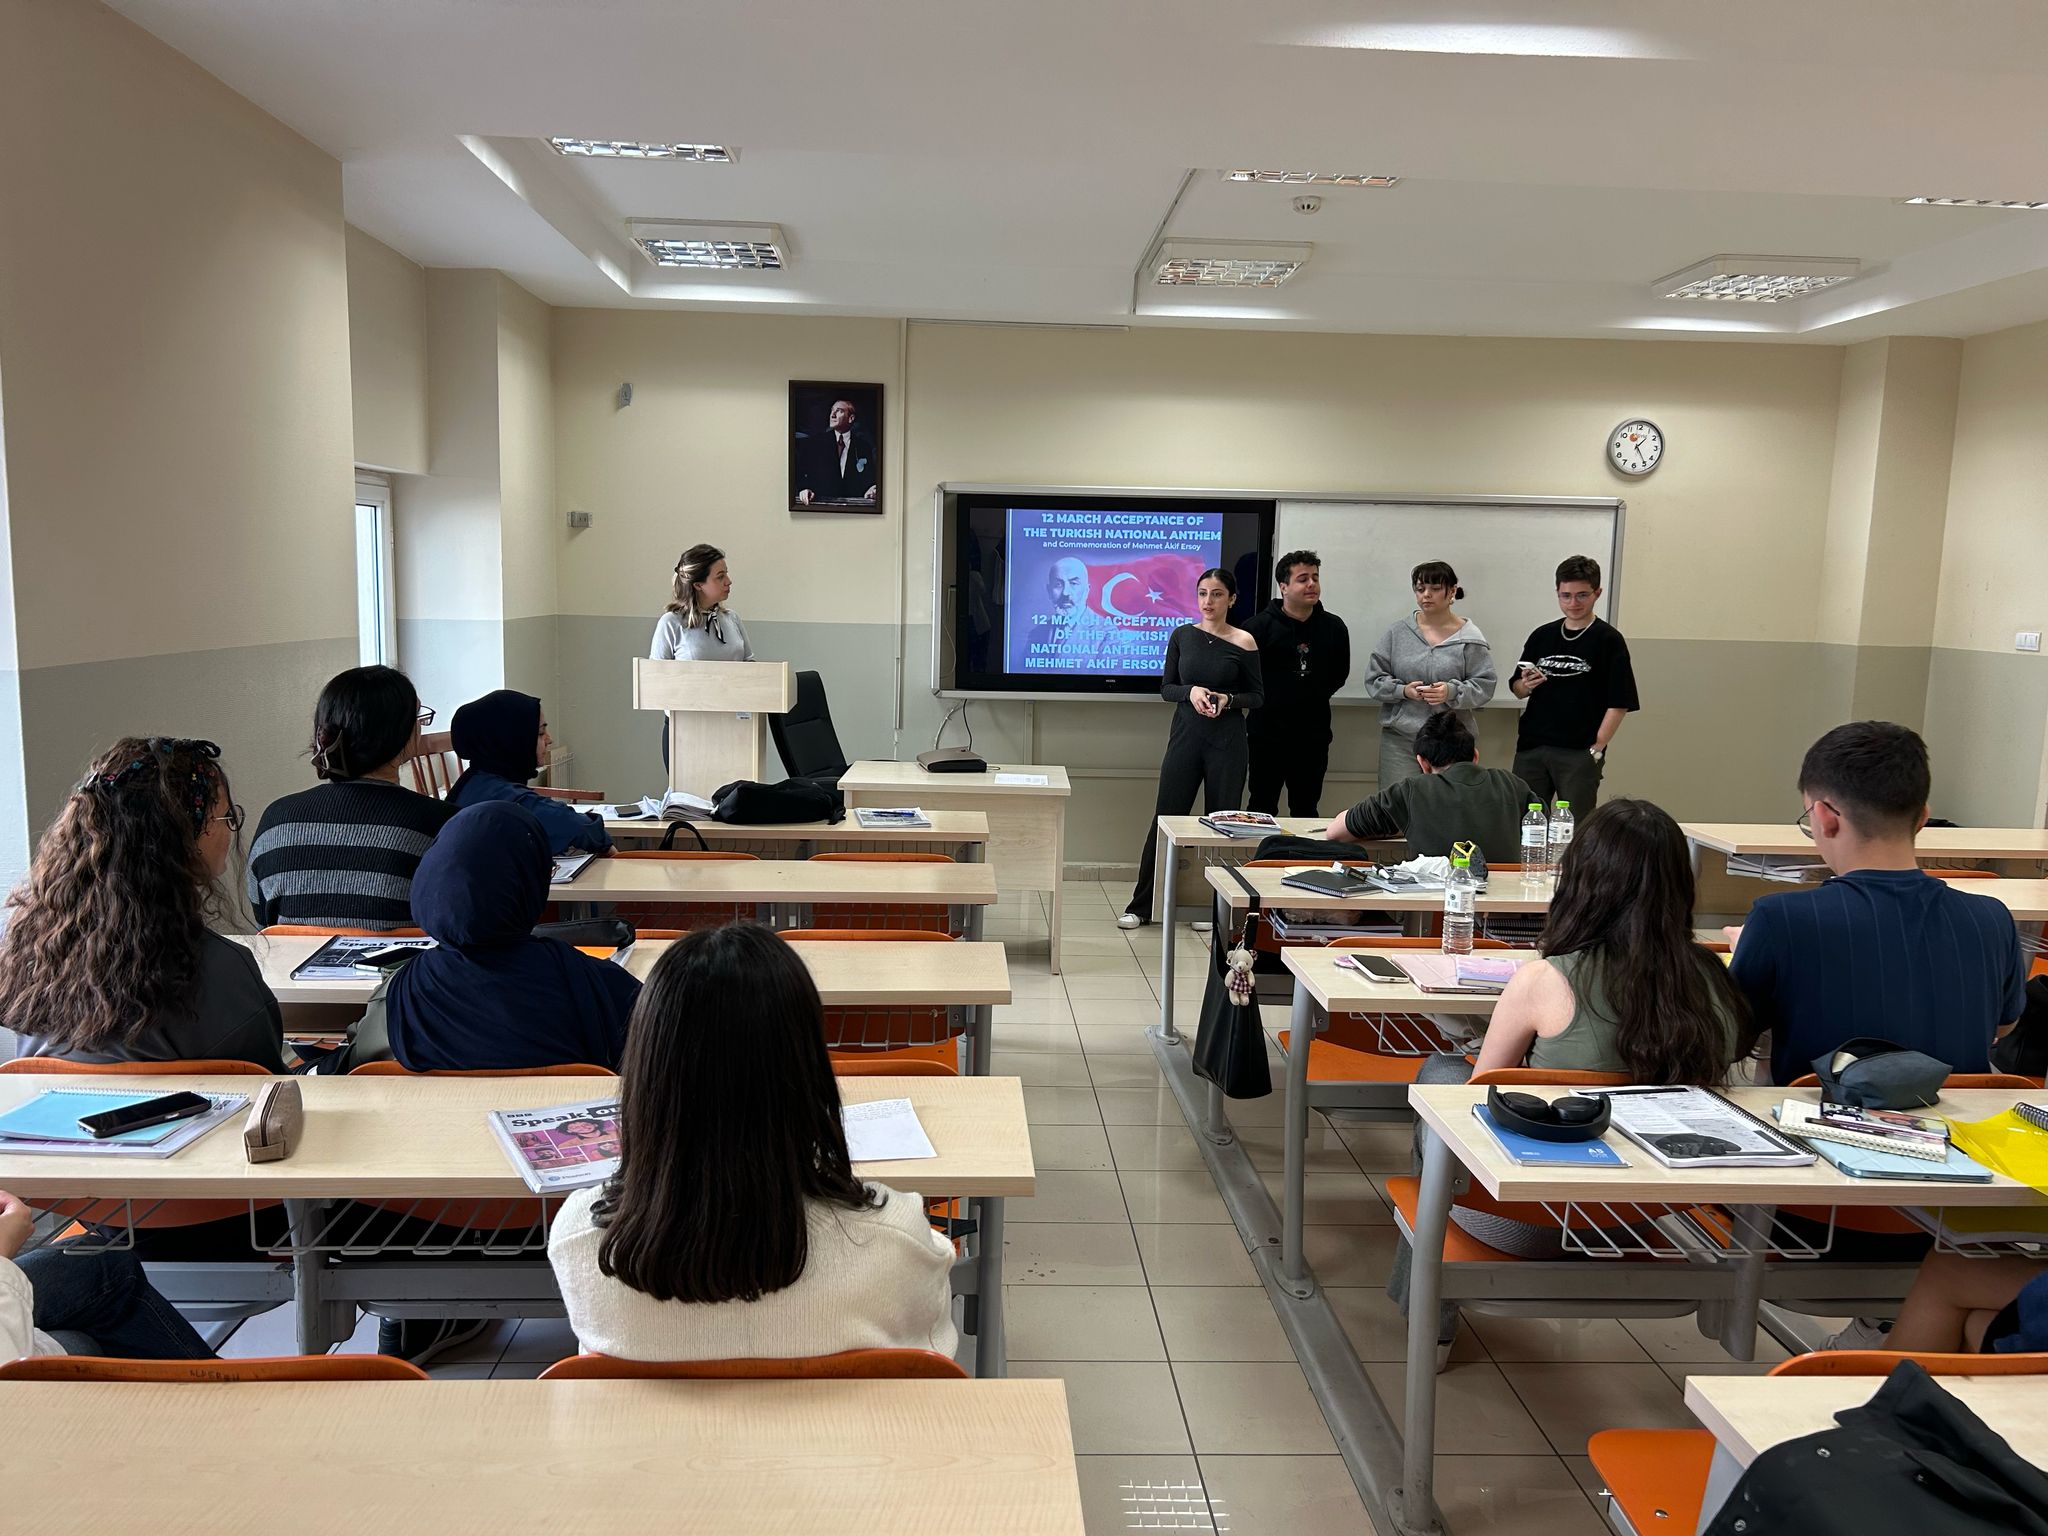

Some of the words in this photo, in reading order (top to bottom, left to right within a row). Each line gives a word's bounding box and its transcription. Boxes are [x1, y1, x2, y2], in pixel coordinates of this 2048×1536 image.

[1041, 513, 1054, 523] 12
[1056, 513, 1101, 524] MARCH
[1104, 514, 1184, 525] ACCEPTANCE
[1186, 516, 1204, 526] OF
[1023, 527, 1047, 538] THE
[1050, 527, 1102, 539] TURKISH
[1105, 529, 1167, 540] NATIONAL
[1169, 530, 1221, 541] ANTHEM
[1059, 541, 1121, 549] Commemoration
[1122, 541, 1131, 549] of
[1132, 542, 1163, 550] Mehmet
[1181, 543, 1201, 552] Ersoy
[1031, 614, 1047, 625] 12
[1051, 615, 1100, 626] MACH
[1103, 616, 1193, 627] ACCEPTANCE
[1078, 630, 1104, 641] THE
[1031, 643, 1099, 655] NATIONAL
[1102, 645, 1160, 656] ANTHEM
[1025, 657, 1083, 668] MEHMET
[1087, 657, 1119, 669] AKİF
[1122, 659, 1166, 670] ERSOY
[511, 1112, 585, 1127] Speak
